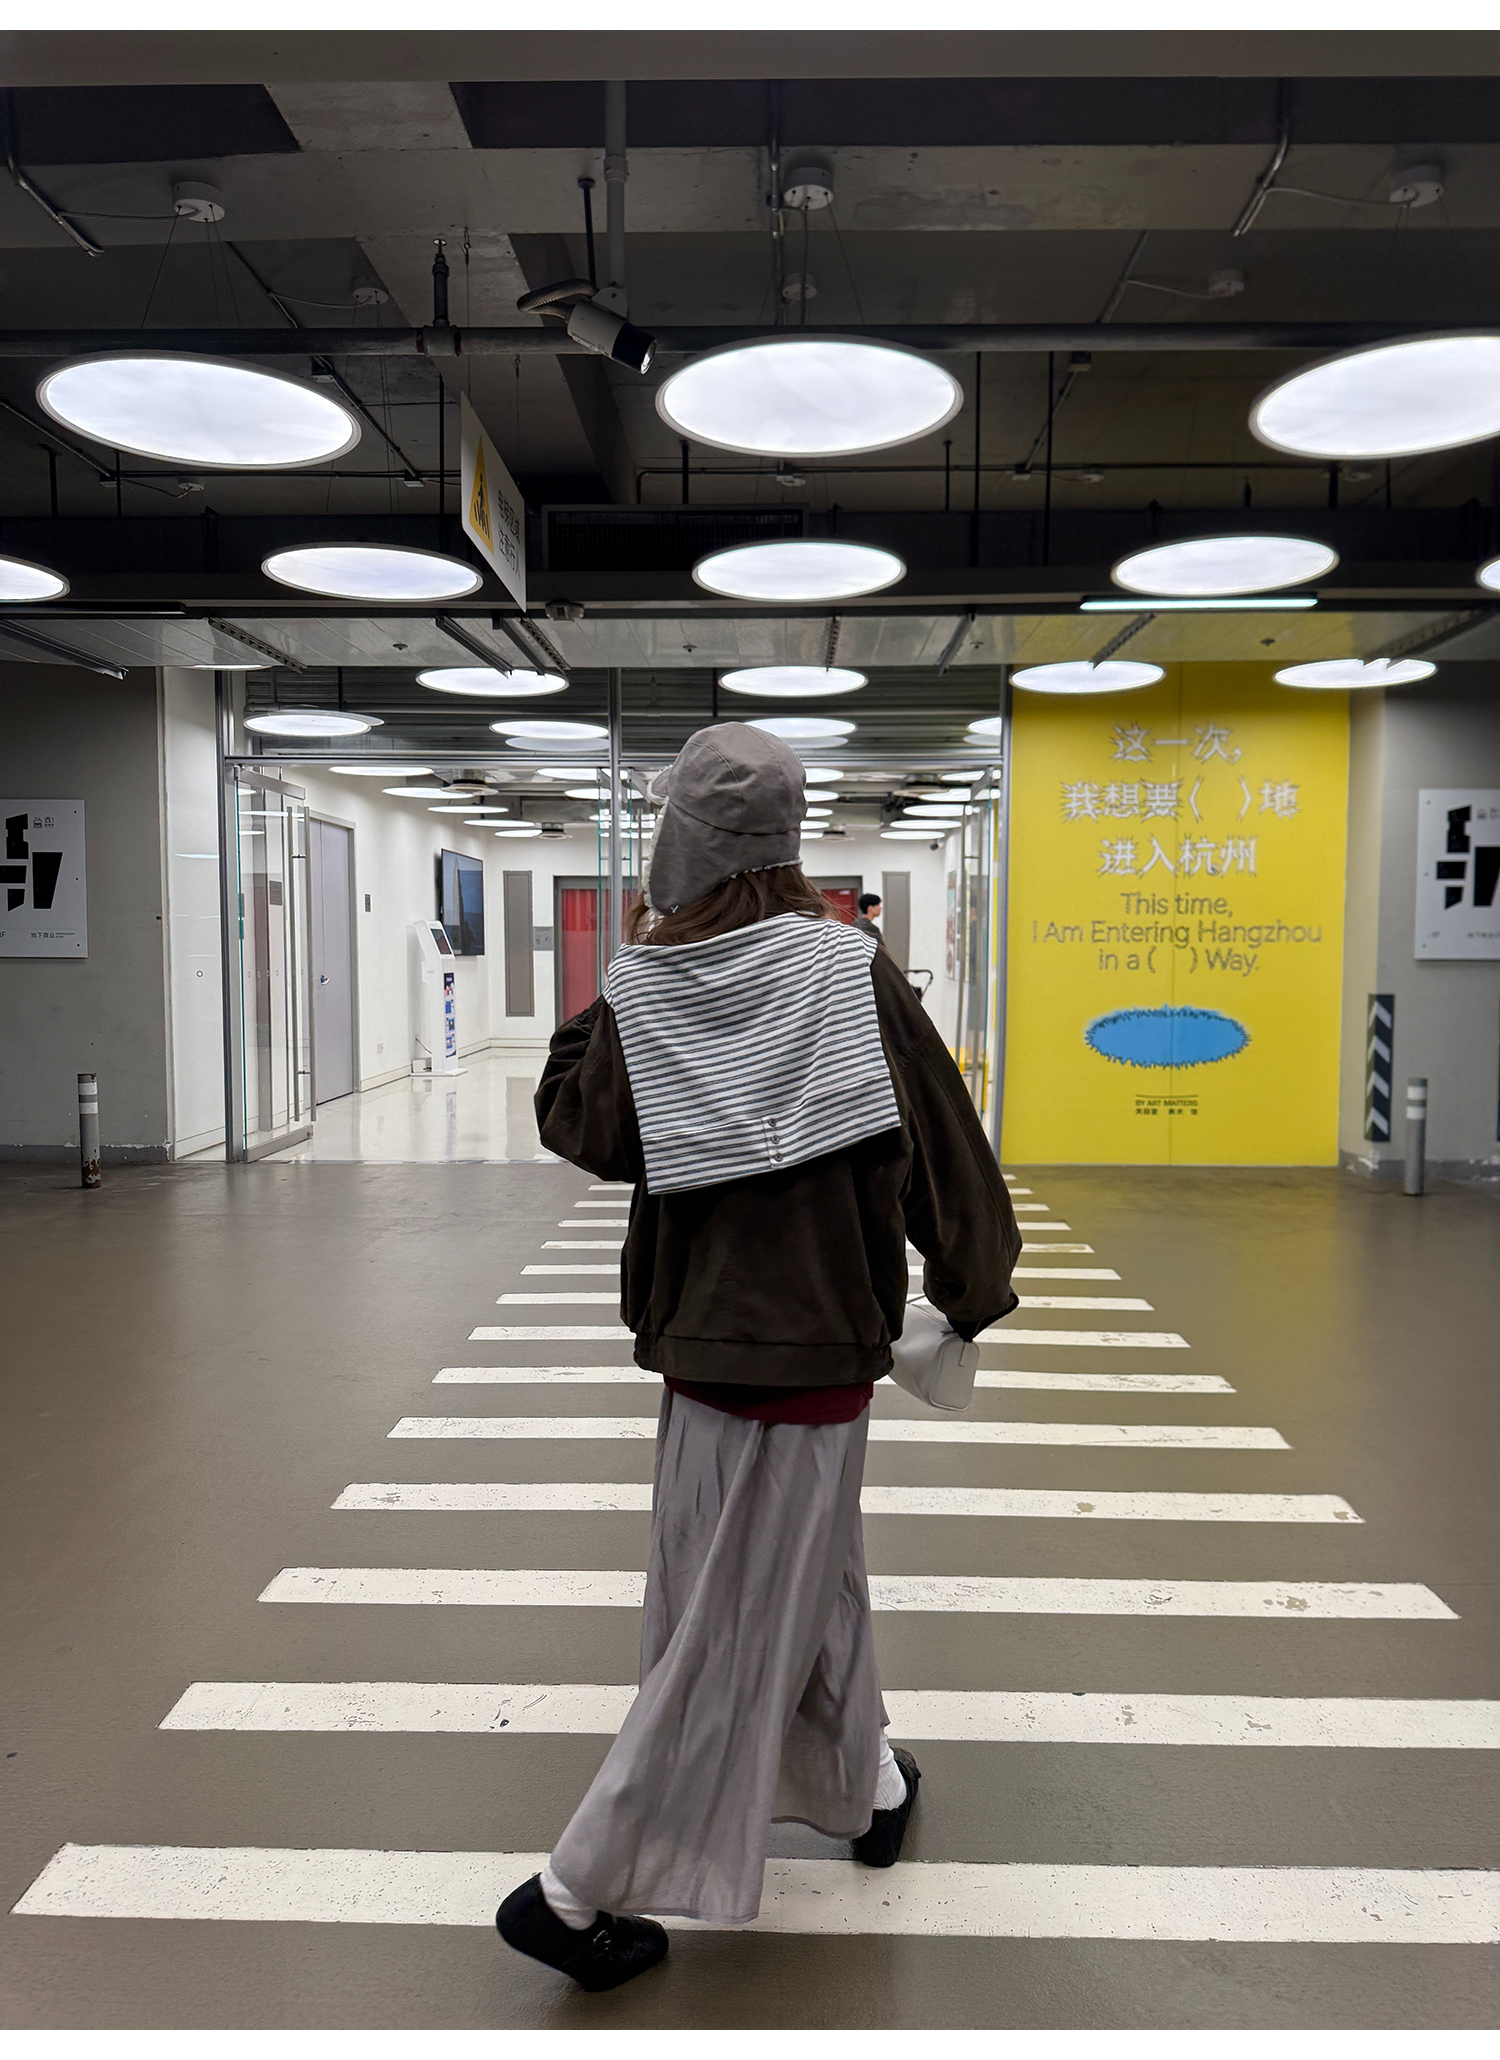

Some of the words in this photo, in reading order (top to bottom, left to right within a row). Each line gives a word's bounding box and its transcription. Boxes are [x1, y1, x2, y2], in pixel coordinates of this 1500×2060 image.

[498, 523, 520, 580] 注意行人
[1110, 722, 1243, 764] 这一次,
[1095, 834, 1257, 878] 进入杭州
[1120, 892, 1168, 915] This
[1174, 893, 1233, 918] time,
[1032, 921, 1038, 943] I
[1043, 921, 1084, 943] Am
[1091, 920, 1190, 949] Entering
[1199, 919, 1323, 948] Hangzhou
[1099, 949, 1118, 970] in
[1126, 953, 1140, 971] a
[1205, 948, 1260, 976] Way.
